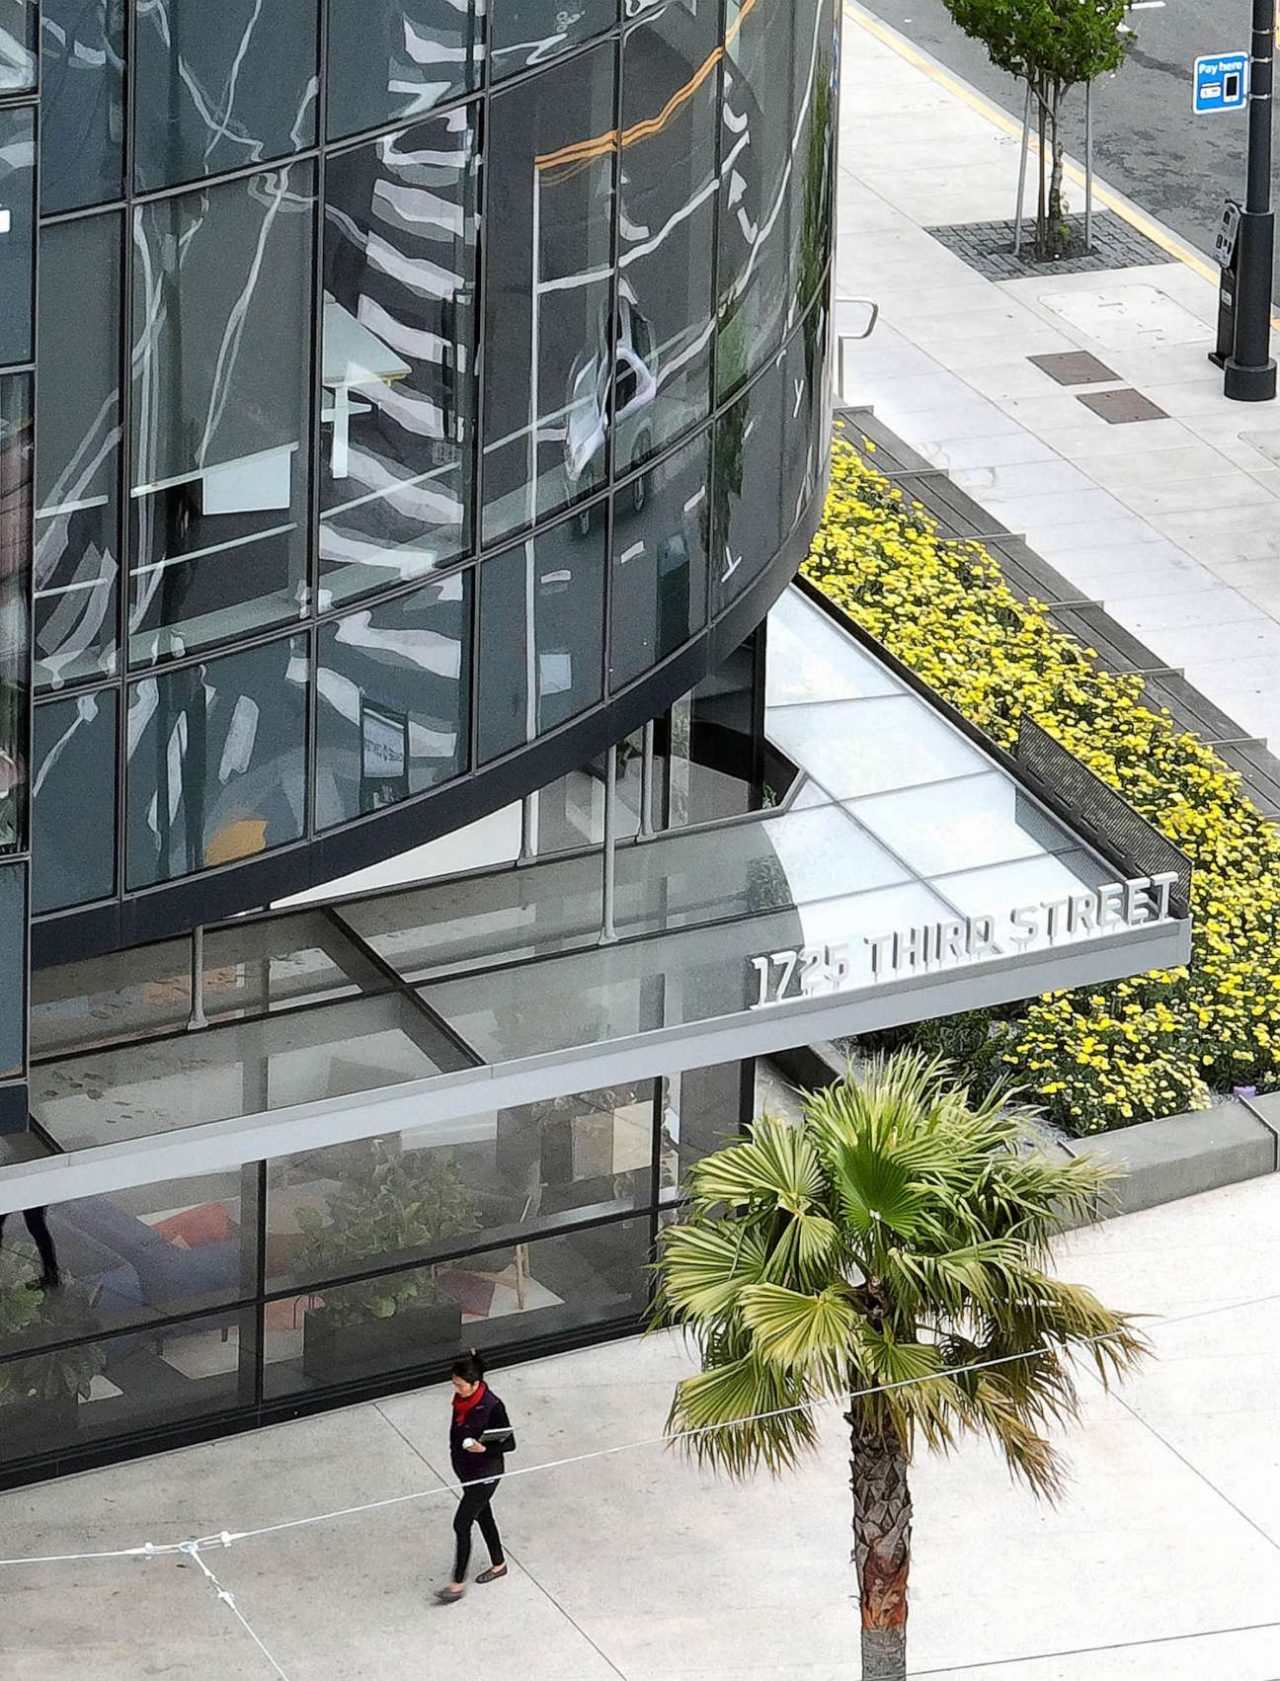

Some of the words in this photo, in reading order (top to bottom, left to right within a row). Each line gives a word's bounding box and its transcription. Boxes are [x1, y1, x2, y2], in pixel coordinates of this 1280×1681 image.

[1199, 63, 1218, 76] Pay
[1219, 61, 1243, 72] here
[749, 941, 849, 1011] 1725
[864, 914, 996, 976] THIRD
[1010, 871, 1179, 945] STREET
